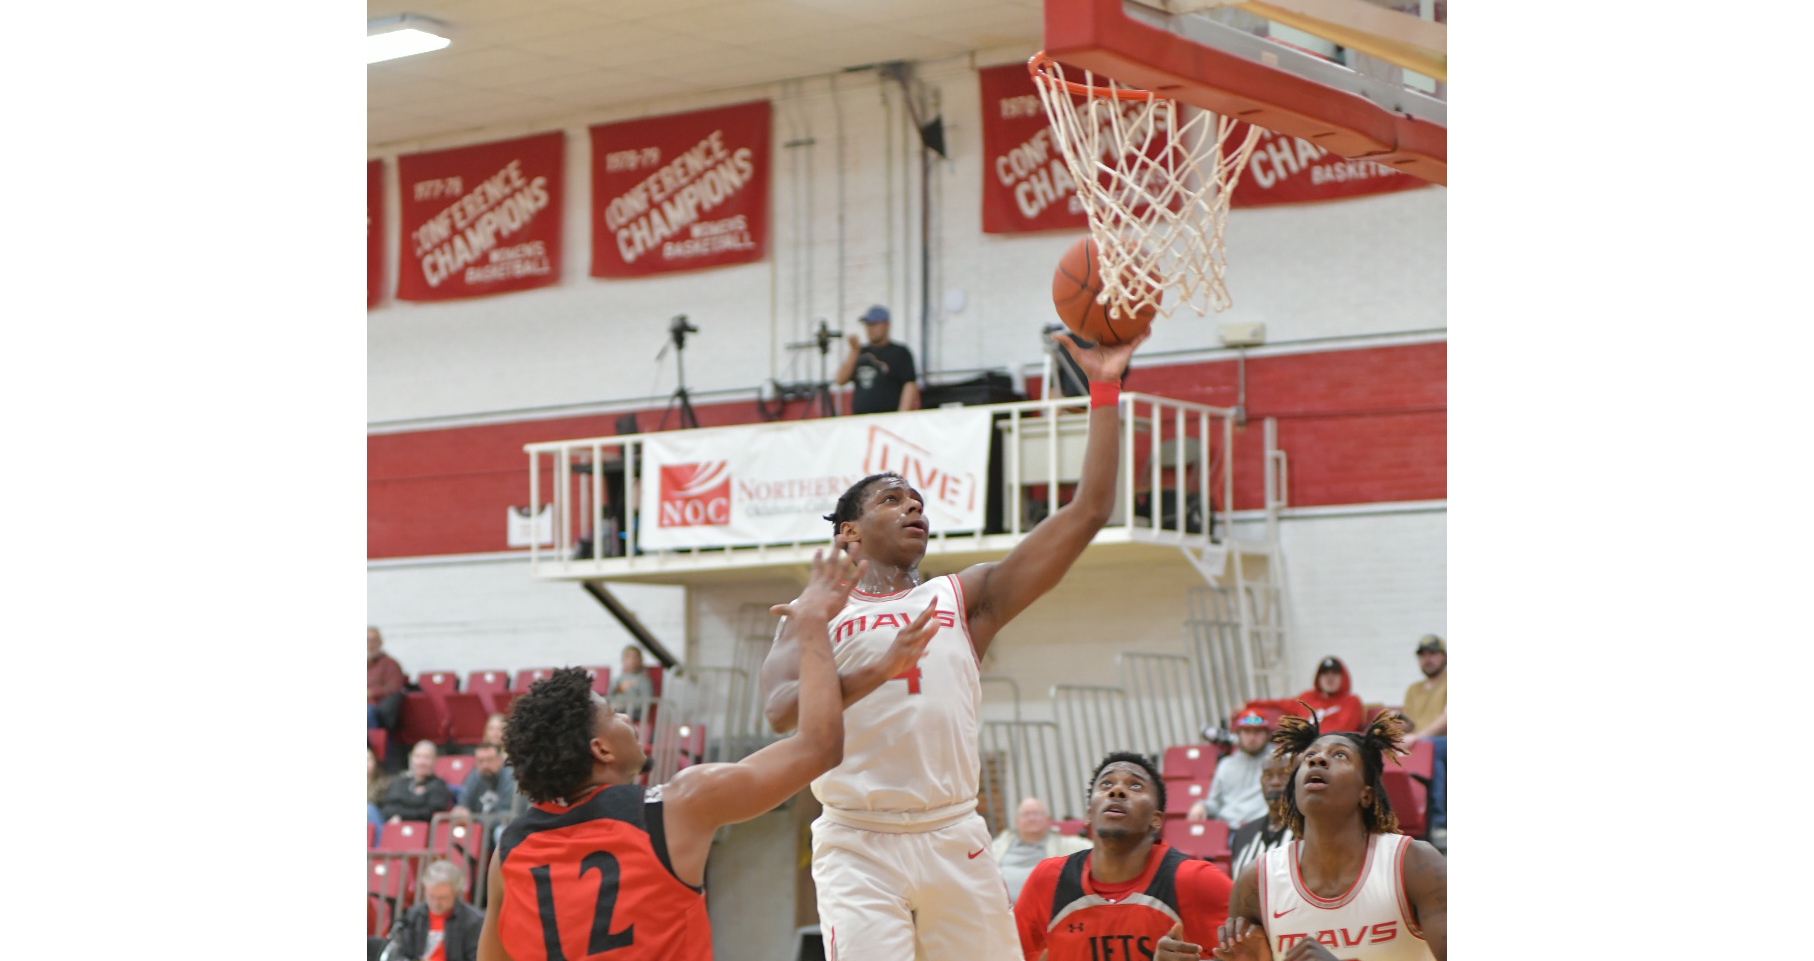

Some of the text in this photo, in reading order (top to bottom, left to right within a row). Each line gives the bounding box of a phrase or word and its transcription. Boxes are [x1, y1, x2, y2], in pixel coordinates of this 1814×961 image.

[411, 158, 528, 258] CONFERENCE
[605, 128, 730, 235] CONFERENCE
[616, 147, 754, 264] CHAMPIONS
[421, 175, 550, 288] CHAMPIONS
[464, 255, 551, 284] BASKETBALL
[662, 231, 757, 260] BASKETBALL
[662, 497, 728, 526] NOC
[879, 443, 963, 506] LIVE
[529, 849, 635, 961] 12
[1278, 920, 1398, 952] MAVS
